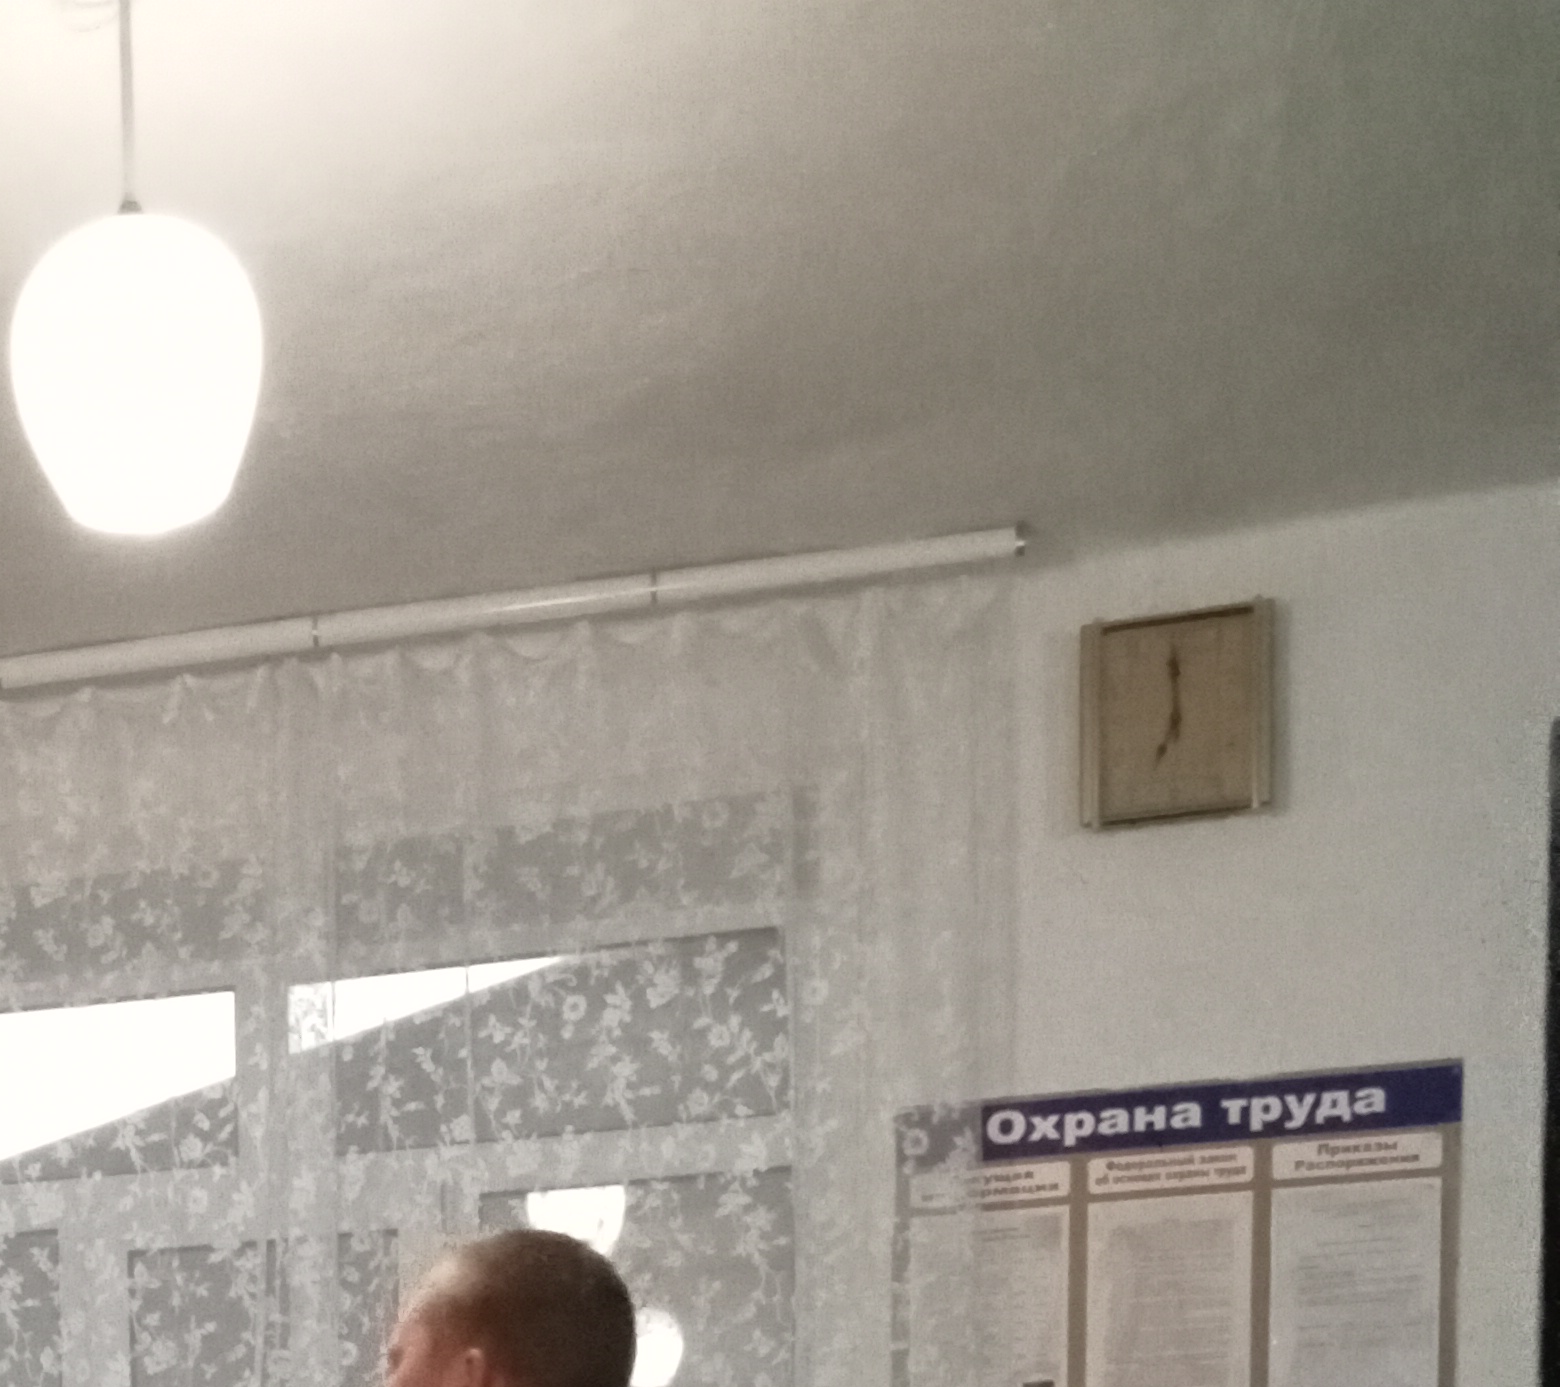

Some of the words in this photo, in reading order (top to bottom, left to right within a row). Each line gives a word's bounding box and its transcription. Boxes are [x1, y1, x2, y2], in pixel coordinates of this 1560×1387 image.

[985, 1101, 1203, 1148] Охрана
[1220, 1085, 1387, 1132] труда
[1318, 1141, 1397, 1158] Приказы
[1294, 1154, 1420, 1172] Распоряжения
